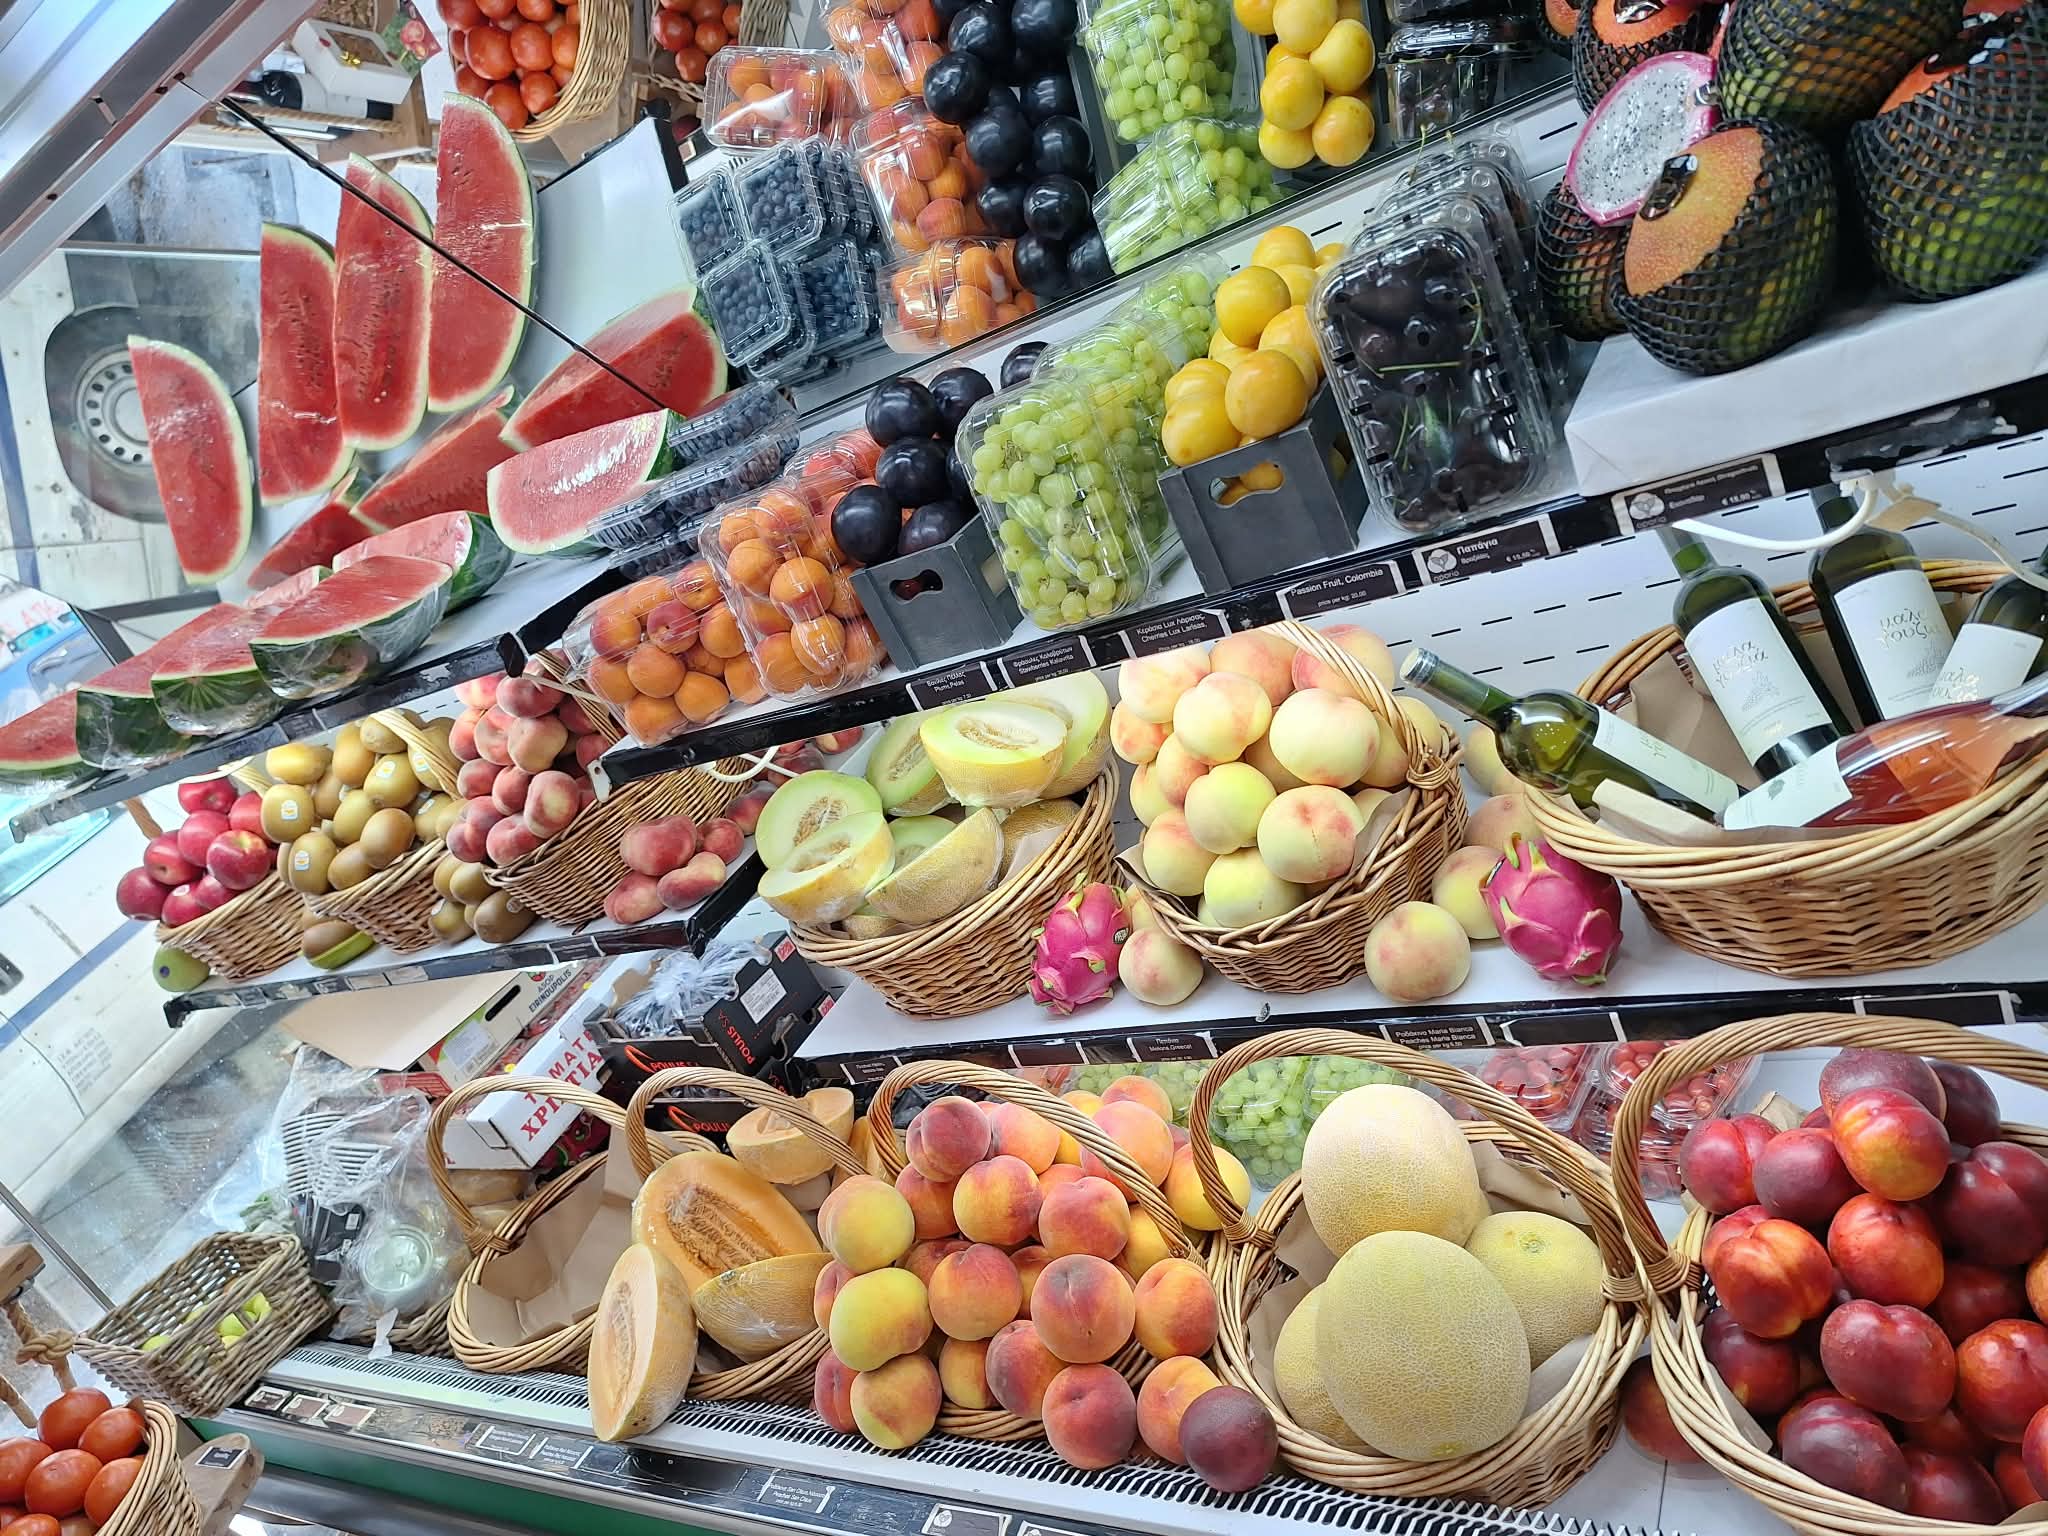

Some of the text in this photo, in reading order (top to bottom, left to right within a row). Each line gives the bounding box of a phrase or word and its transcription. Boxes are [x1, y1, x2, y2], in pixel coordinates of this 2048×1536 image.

[1456, 538, 1498, 554] Παπάγια
[1291, 584, 1322, 597] Passion
[1345, 568, 1383, 584] Colombia
[1141, 632, 1168, 643] Cherries
[1169, 627, 1181, 637] Lux
[1163, 620, 1176, 629] Lux
[529, 969, 572, 1013] EIRINOUPOLIS
[727, 1026, 756, 1065] POULIS
[520, 1051, 603, 1142] ΧΡΙΤΙΑ
[693, 1122, 732, 1132] POULI
